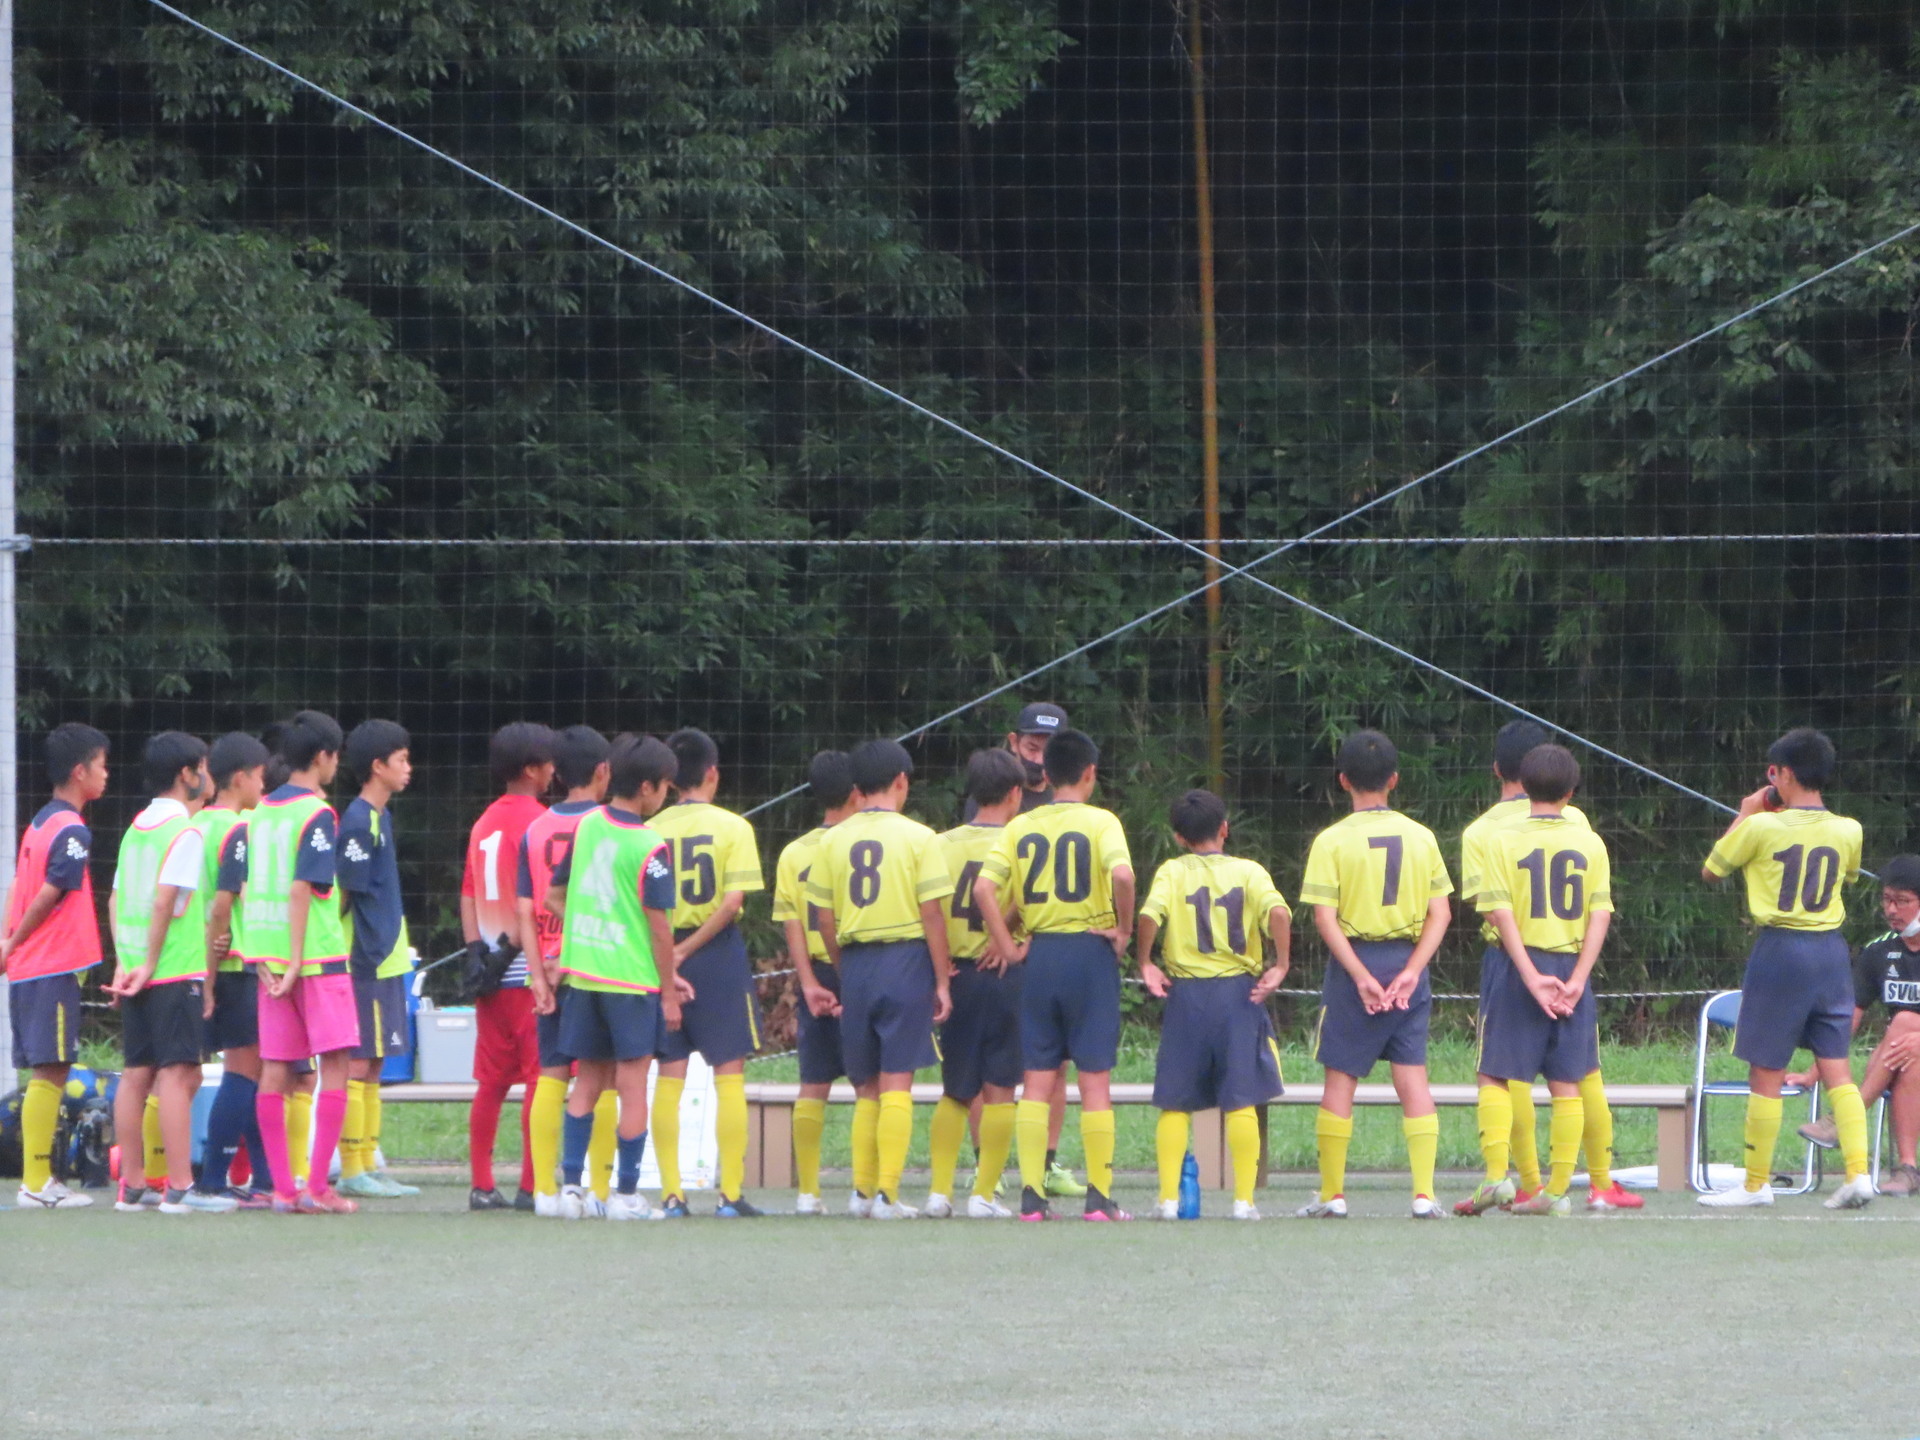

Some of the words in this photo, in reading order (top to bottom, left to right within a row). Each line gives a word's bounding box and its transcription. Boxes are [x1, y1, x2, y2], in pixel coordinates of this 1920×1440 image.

[479, 830, 502, 901] 1
[848, 839, 884, 909] 8
[1016, 831, 1092, 905] 20
[1367, 834, 1404, 907] 7
[1516, 847, 1589, 921] 16
[1772, 843, 1841, 913] 10
[1185, 885, 1246, 955] 11
